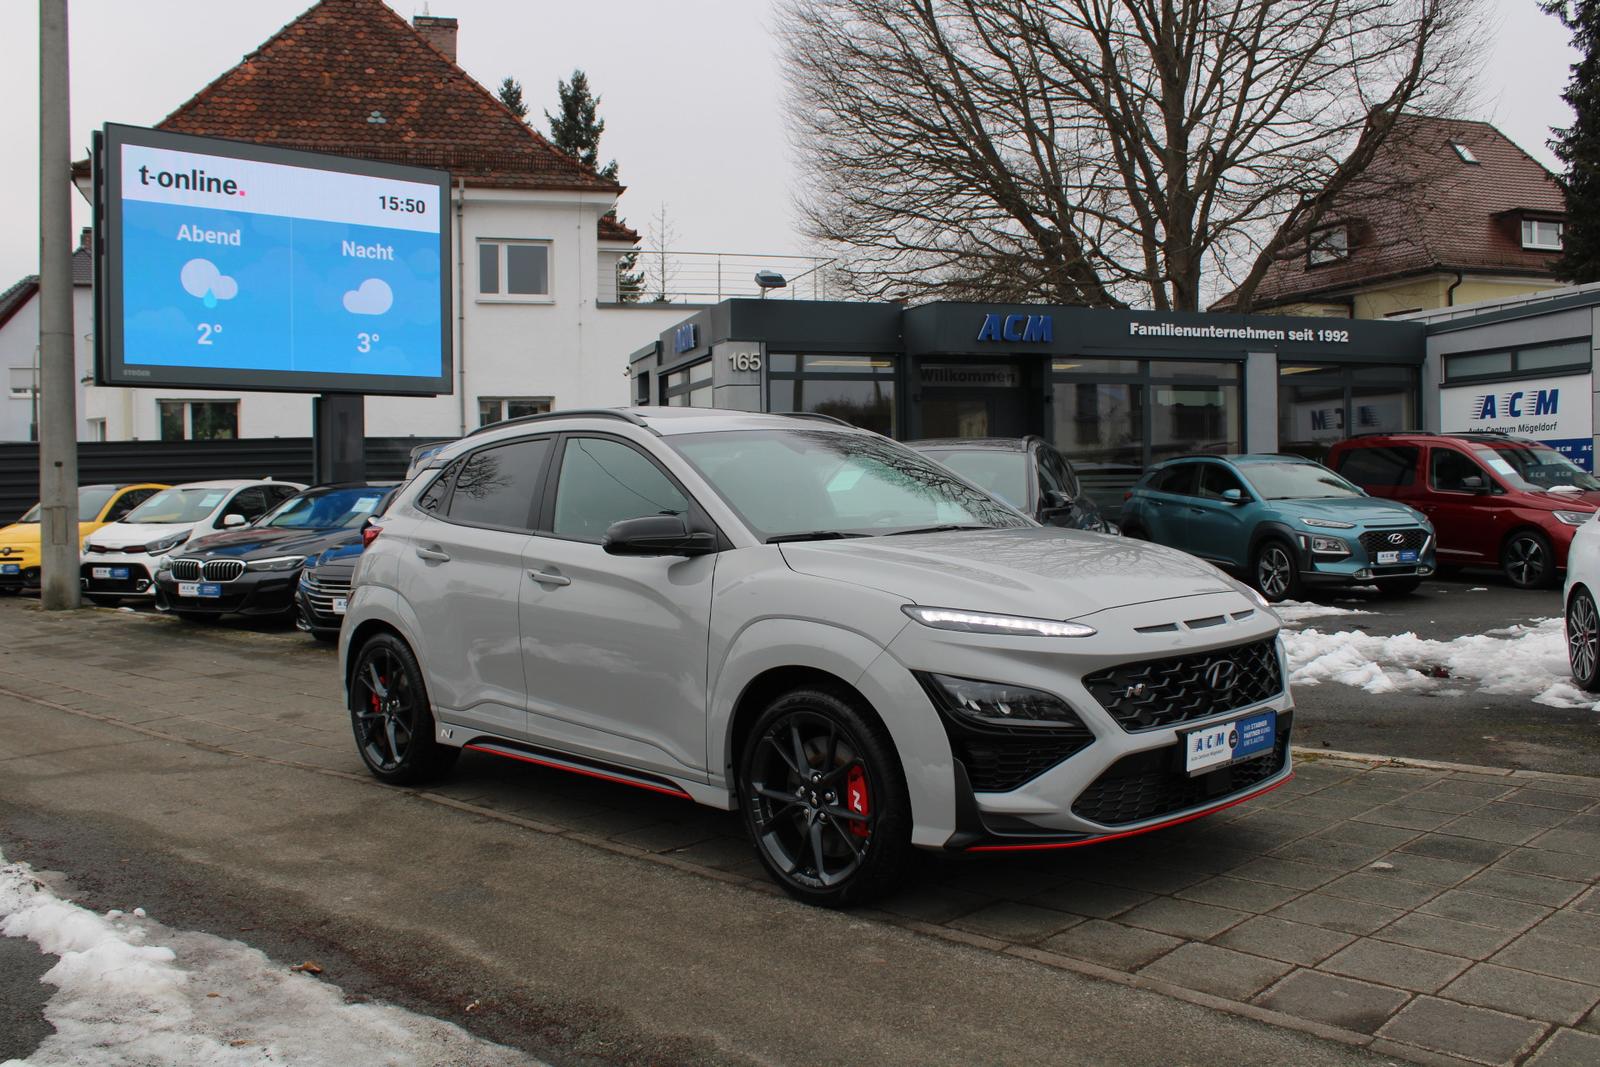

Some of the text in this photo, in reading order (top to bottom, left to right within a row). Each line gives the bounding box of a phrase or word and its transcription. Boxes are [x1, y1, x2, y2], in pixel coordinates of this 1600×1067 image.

[138, 164, 246, 196] t-online.
[378, 195, 426, 214] 15:50
[176, 224, 241, 247] Abend
[341, 240, 394, 261] Nacht
[197, 323, 223, 345] 2°
[977, 313, 1054, 343] ACM
[1129, 322, 1349, 342] Familienunternehmen seit 1992
[357, 332, 380, 353] 3°
[728, 352, 762, 372] 165
[920, 367, 1017, 383] Willkommen
[1470, 388, 1560, 420] ACM
[1517, 421, 1558, 435] Mögeldorf
[1193, 732, 1225, 753] ACM
